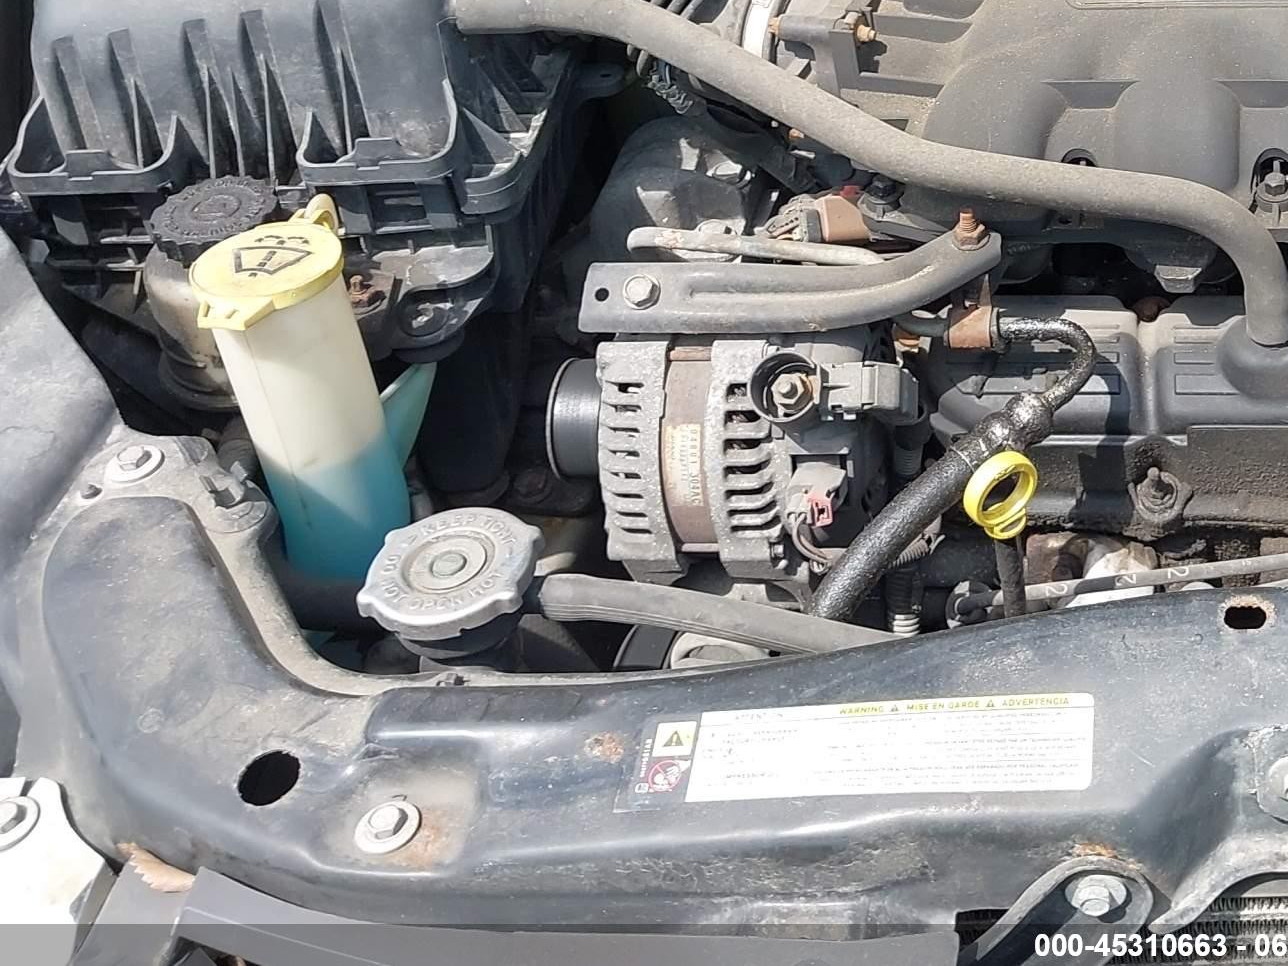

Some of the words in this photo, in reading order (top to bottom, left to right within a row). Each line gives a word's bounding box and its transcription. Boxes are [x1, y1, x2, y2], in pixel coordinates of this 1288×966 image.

[421, 513, 477, 536] KEEP
[479, 514, 517, 546] TIGHT
[381, 554, 402, 576] DO
[408, 595, 465, 612] OPEN
[468, 572, 503, 599] HOT
[838, 705, 885, 716] WARNING
[906, 703, 931, 712] MISE
[931, 702, 946, 711] EN
[948, 700, 981, 711] GARDE
[1001, 697, 1071, 708] ADVERTENCIA
